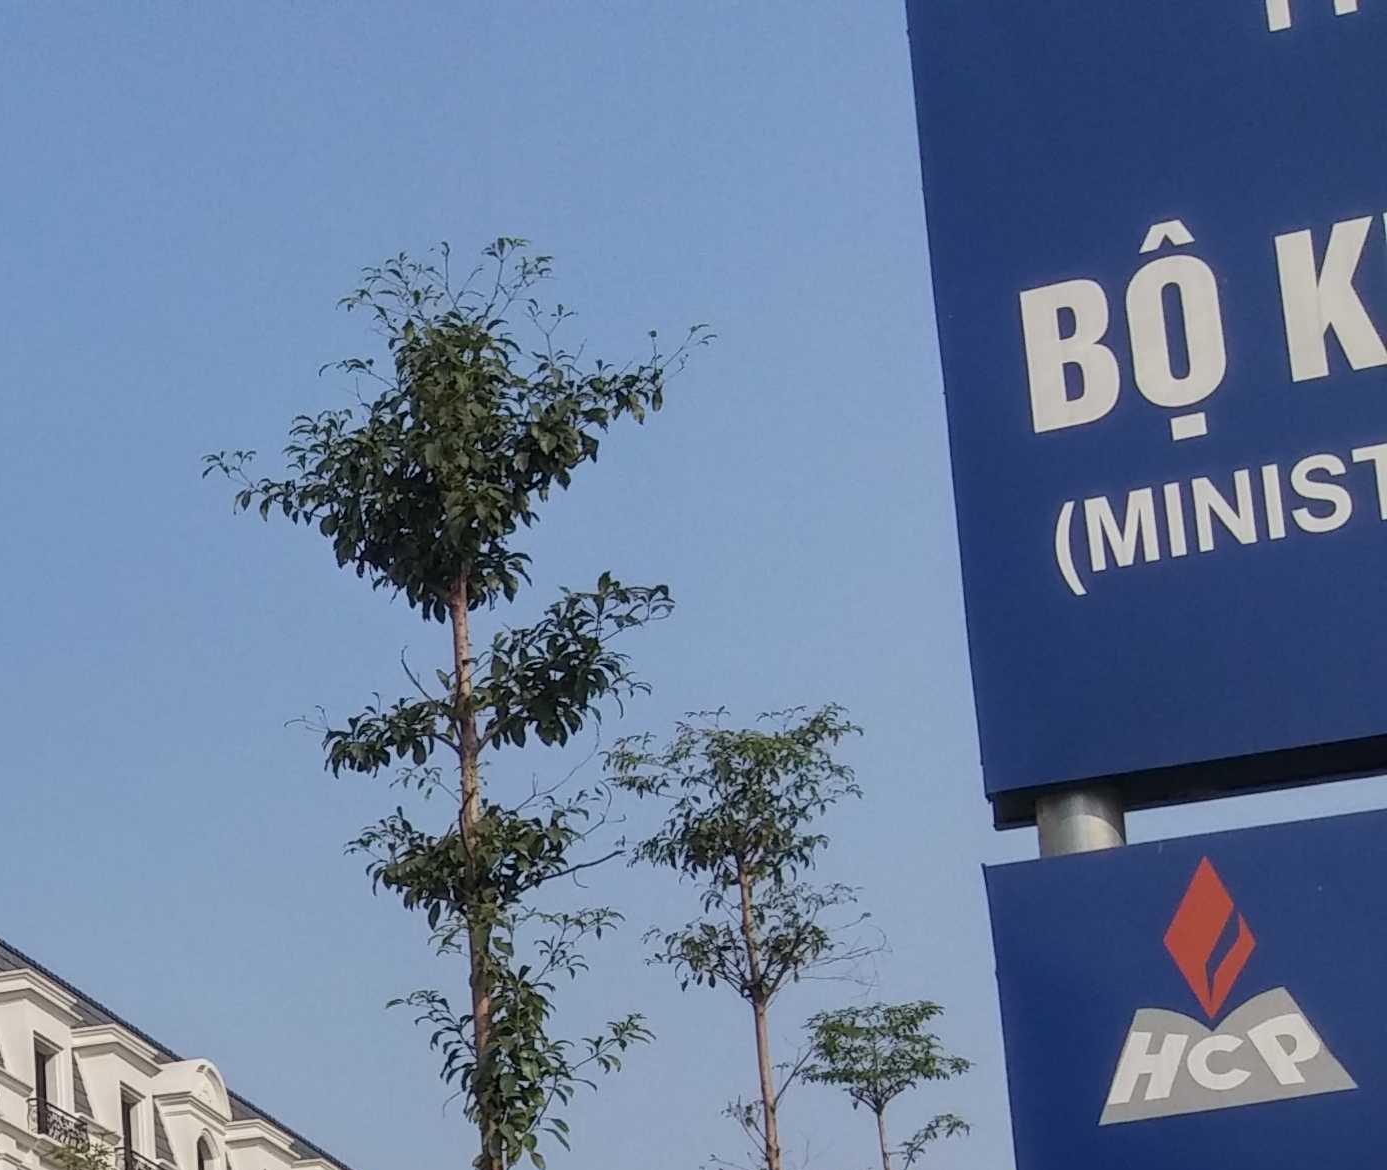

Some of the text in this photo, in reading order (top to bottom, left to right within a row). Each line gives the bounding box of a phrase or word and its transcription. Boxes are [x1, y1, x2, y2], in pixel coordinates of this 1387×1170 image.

[1019, 211, 1387, 441] BỘ K
[1106, 1013, 1322, 1104] HCP
